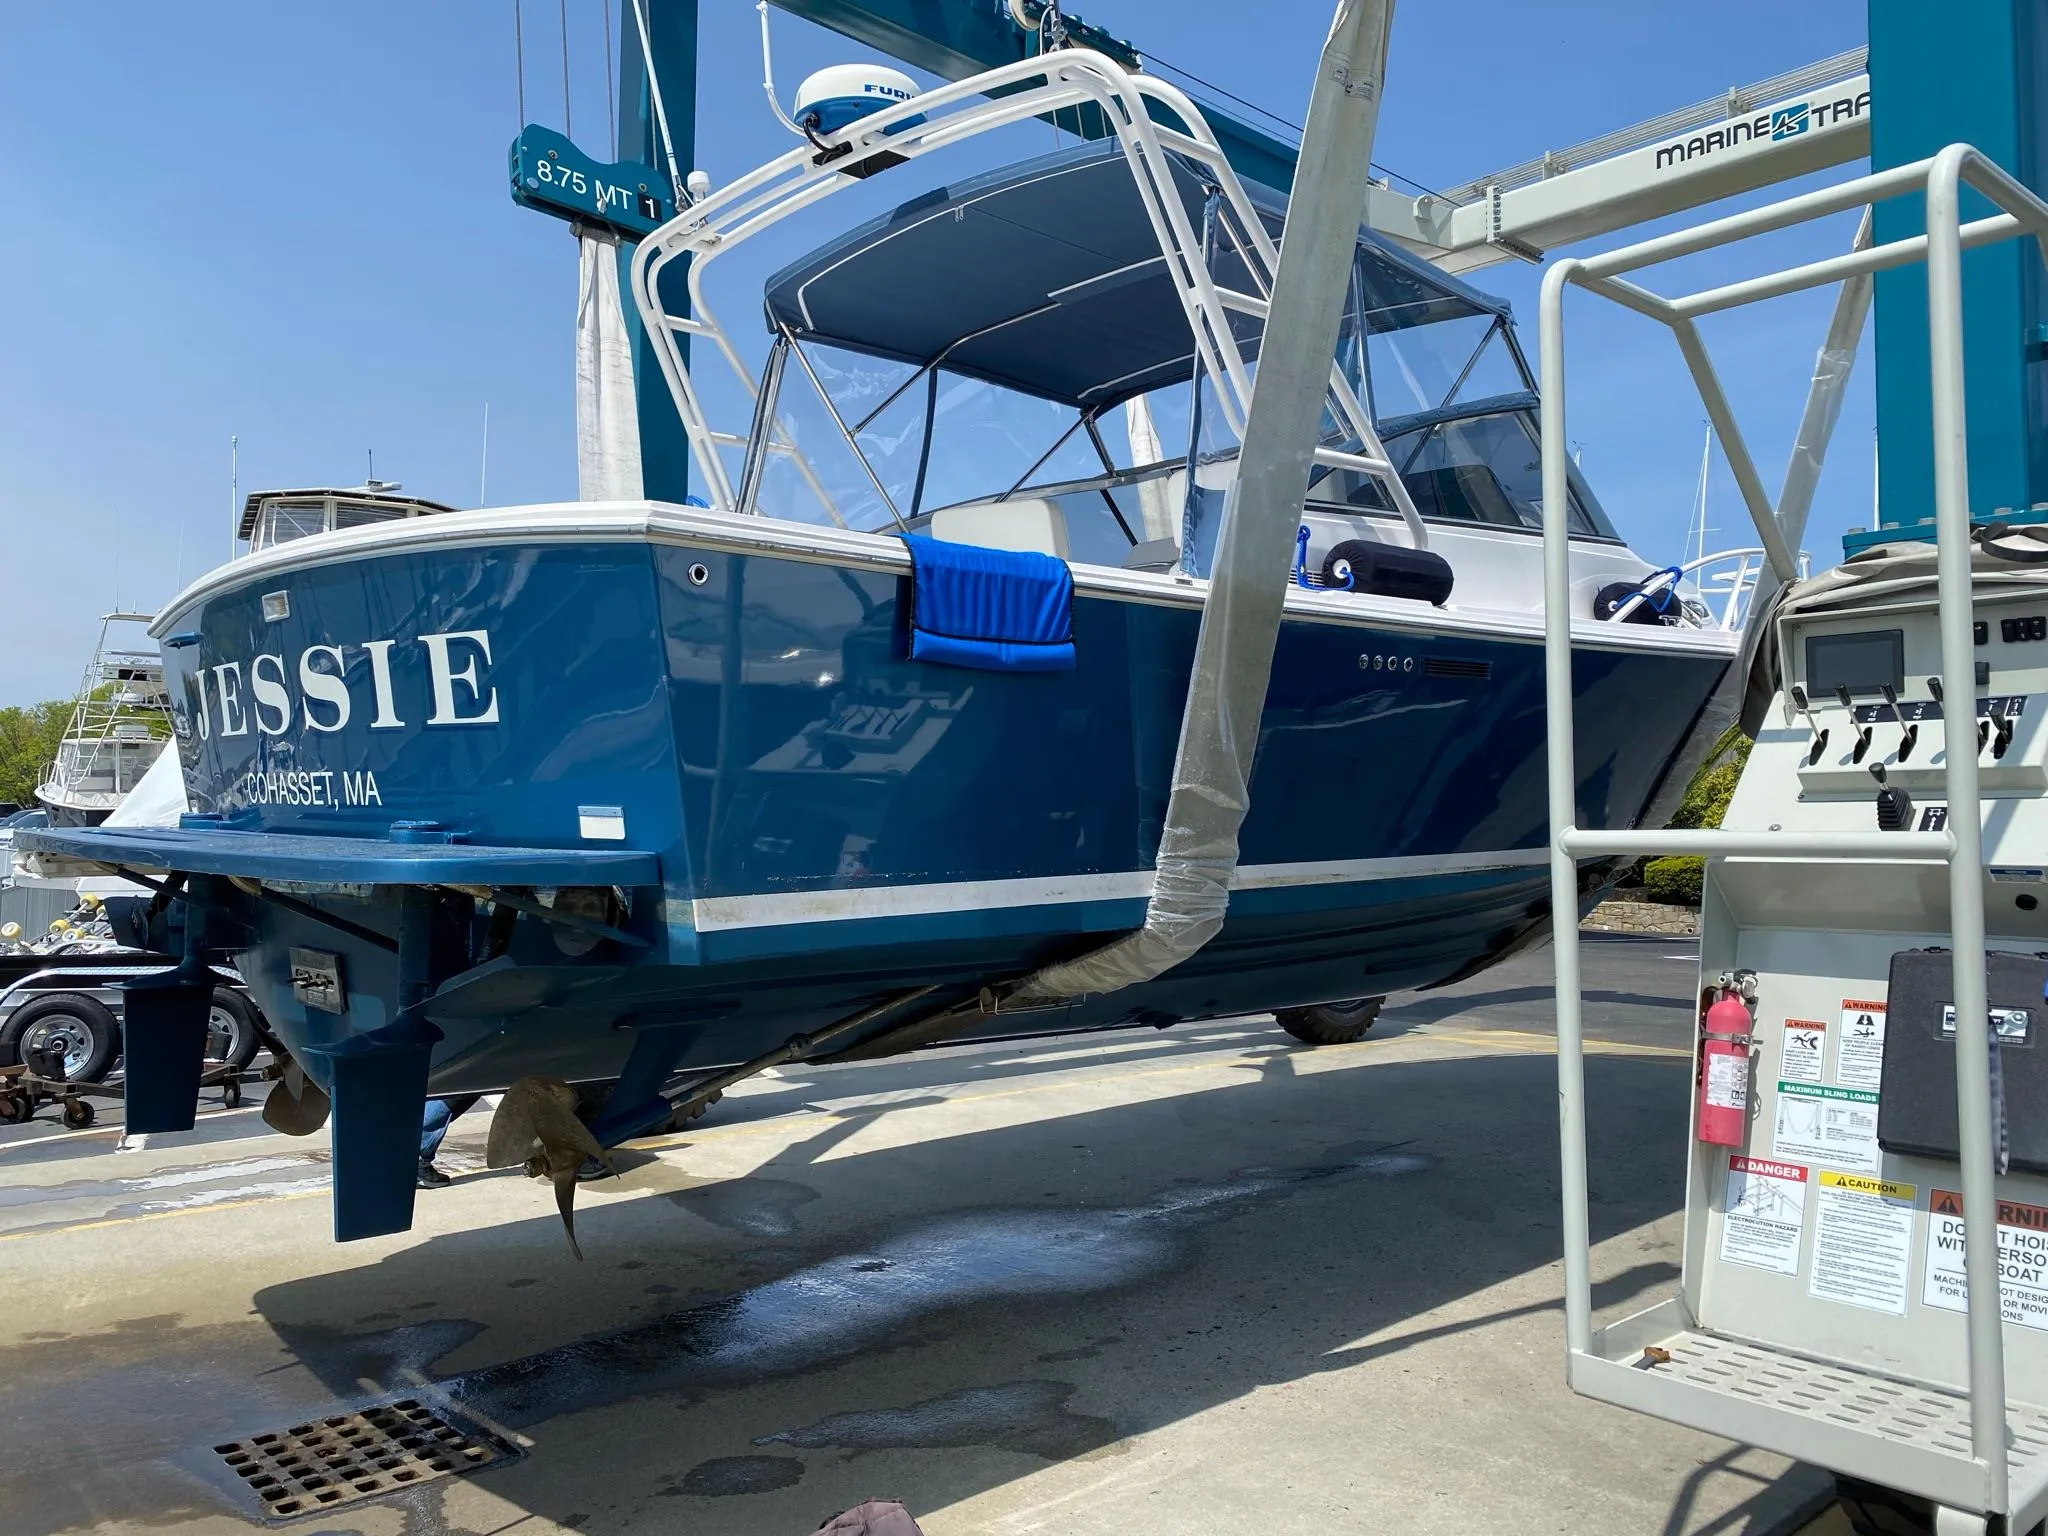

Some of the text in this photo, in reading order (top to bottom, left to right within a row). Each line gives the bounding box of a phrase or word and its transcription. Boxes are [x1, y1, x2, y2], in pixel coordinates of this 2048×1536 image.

[1656, 114, 1770, 169] MARINE
[537, 160, 632, 209] 8.75 MT
[645, 198, 655, 218] 1
[194, 629, 500, 741] JESSIE
[247, 770, 382, 812] COHASSET, MA
[1793, 1021, 1825, 1030] WARNING
[1784, 1084, 1877, 1102] MAXIMUM SLING LOADS
[1748, 1161, 1800, 1179] DANGER
[1848, 1178, 1898, 1194] CAUTION
[1728, 1214, 1798, 1232] ELECTROCUTION HAZARD
[1937, 1235, 1966, 1252] WIT
[2015, 1234, 2048, 1251] HOI
[1939, 1286, 1960, 1296] FOR
[2003, 1299, 2018, 1309] OR
